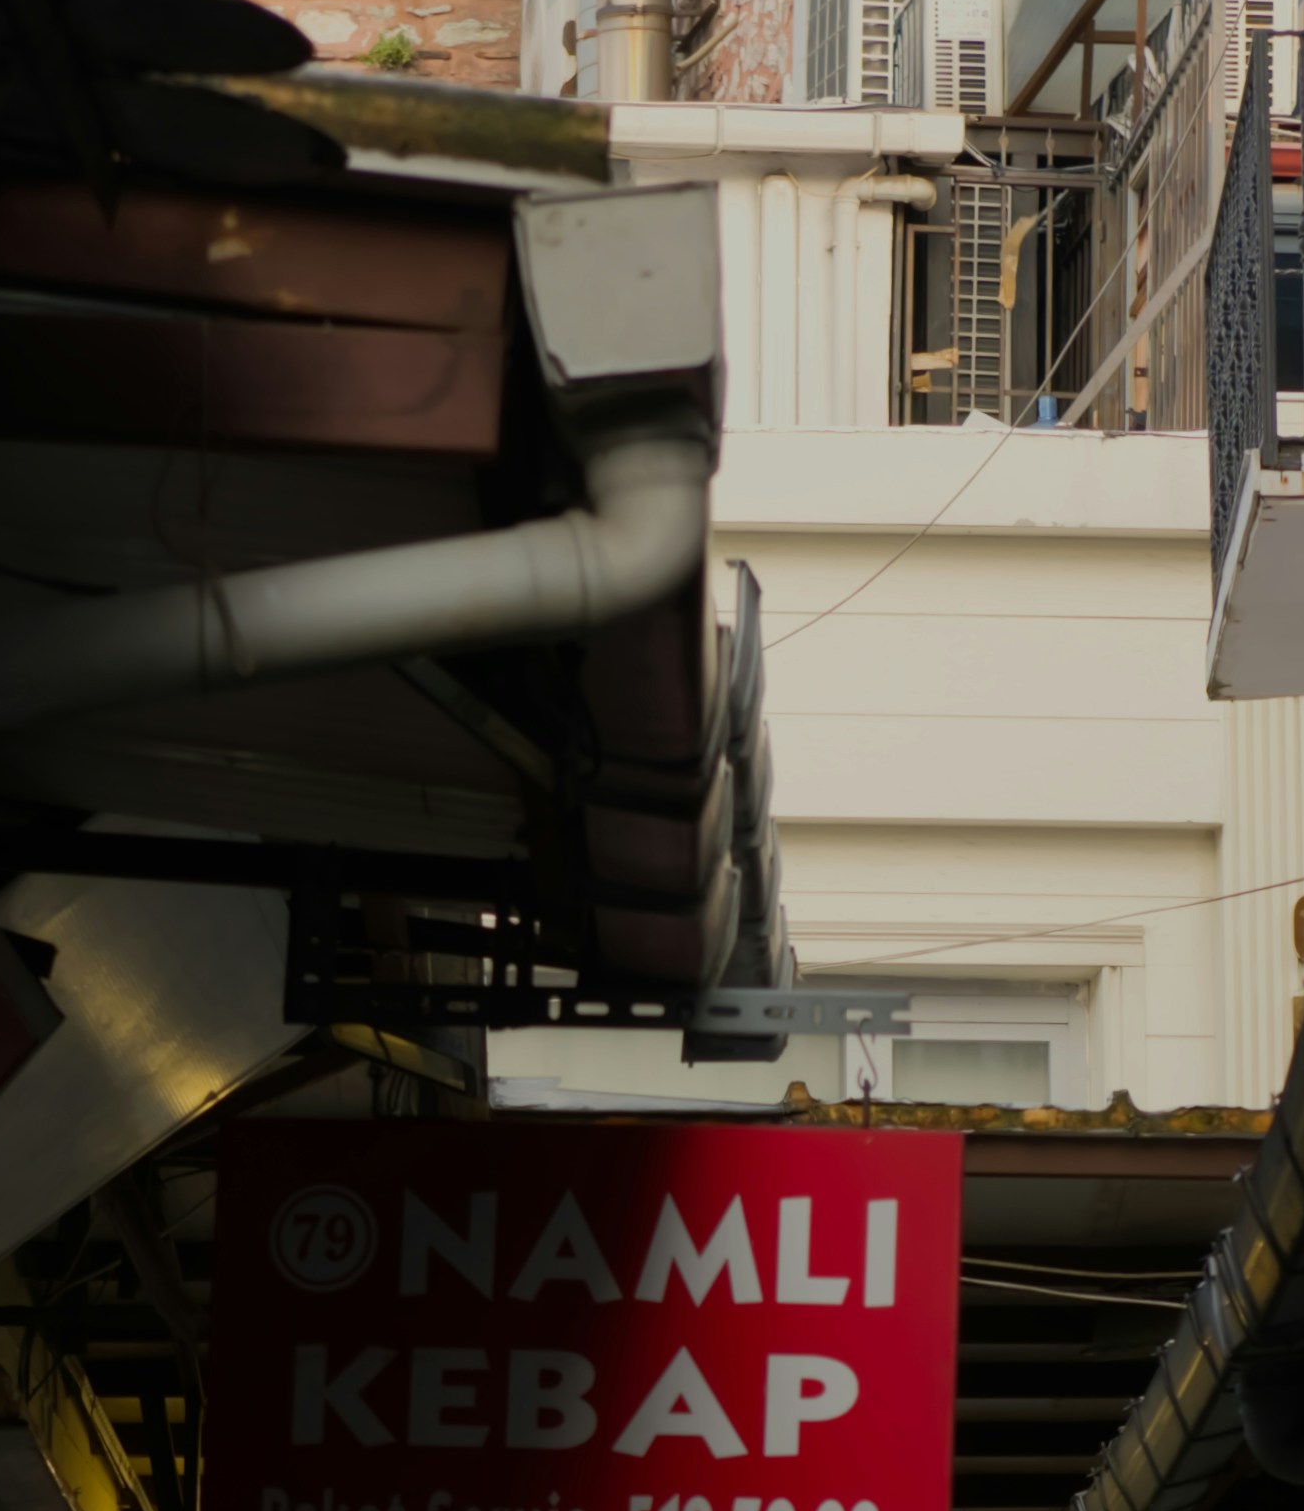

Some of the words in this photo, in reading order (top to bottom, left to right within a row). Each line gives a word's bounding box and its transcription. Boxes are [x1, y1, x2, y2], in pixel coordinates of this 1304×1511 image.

[292, 1212, 353, 1263] 79
[397, 1185, 900, 1311] NAMLI
[289, 1340, 864, 1461] KEBAP
